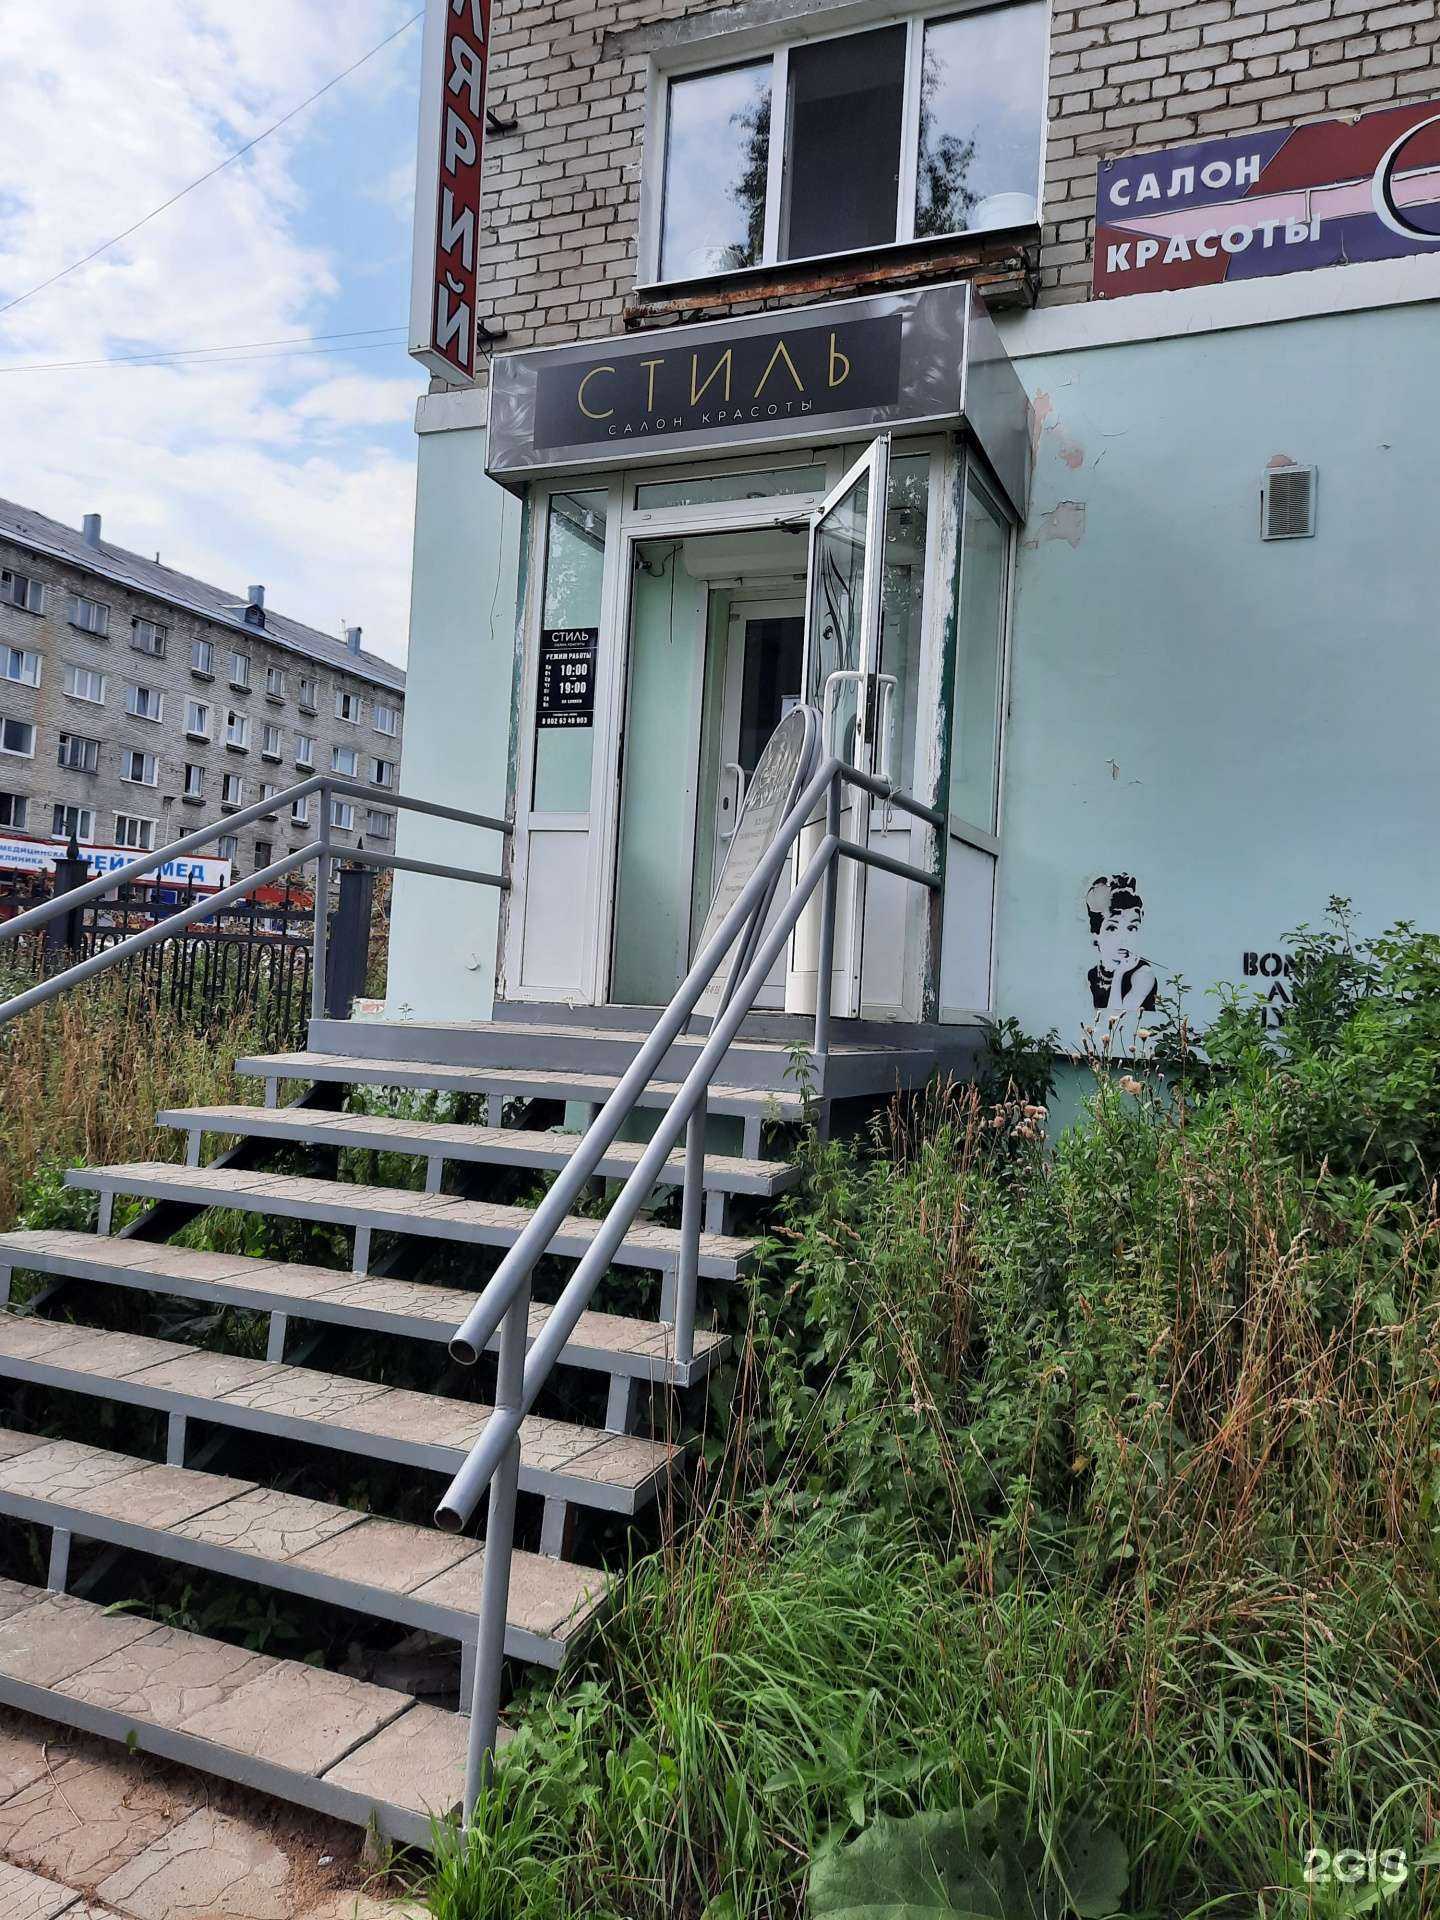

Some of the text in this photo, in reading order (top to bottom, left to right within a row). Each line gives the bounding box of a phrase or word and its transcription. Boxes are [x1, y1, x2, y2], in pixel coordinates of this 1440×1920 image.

[1109, 154, 1260, 206] САЛОН
[1106, 212, 1321, 273] КРАСОТЫ
[577, 332, 850, 419] СТИЛЬ
[608, 400, 813, 436] САЛОН КРАСОТЫ
[551, 631, 589, 642] СТИЛЬ
[560, 663, 588, 676] 10:00
[559, 682, 587, 694] 19:00
